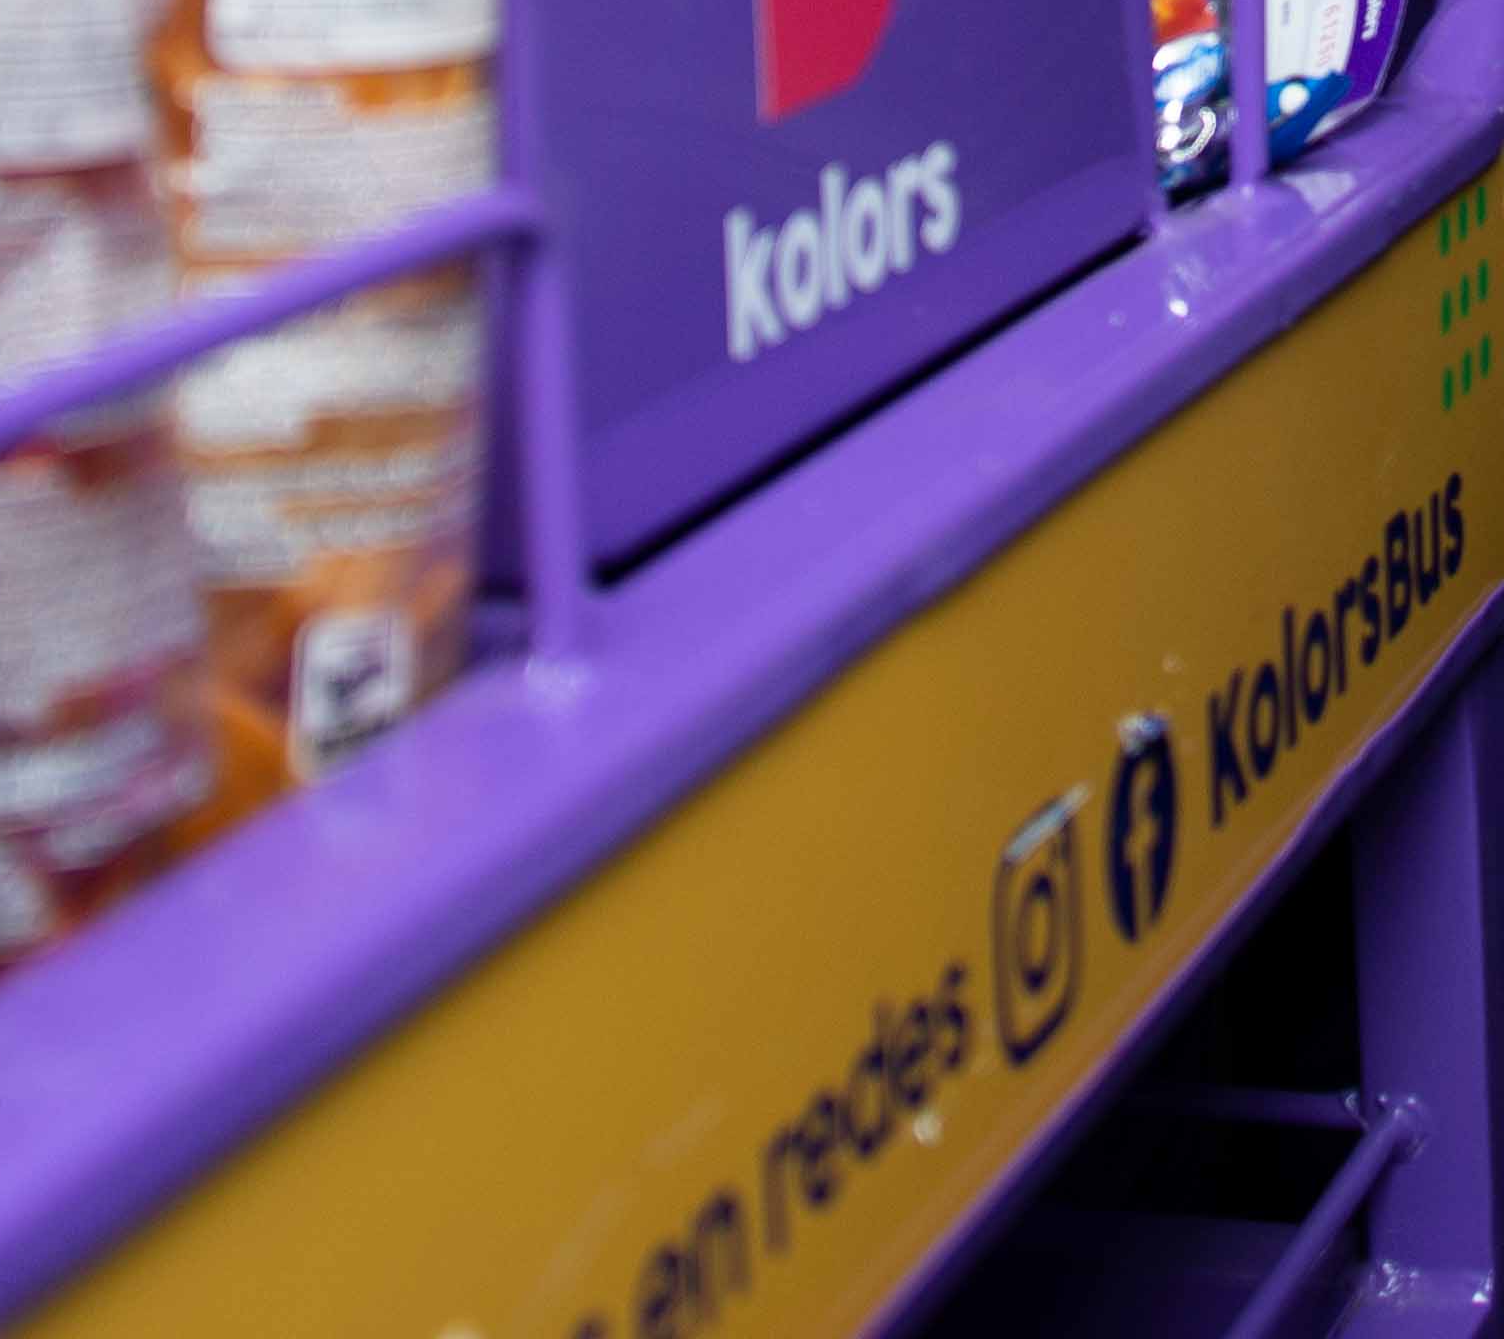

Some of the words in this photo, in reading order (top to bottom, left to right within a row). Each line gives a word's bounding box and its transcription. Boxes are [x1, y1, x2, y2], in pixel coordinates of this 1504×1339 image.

[723, 139, 961, 363] kolors
[634, 1189, 752, 1339] en
[764, 964, 970, 1253] redes
